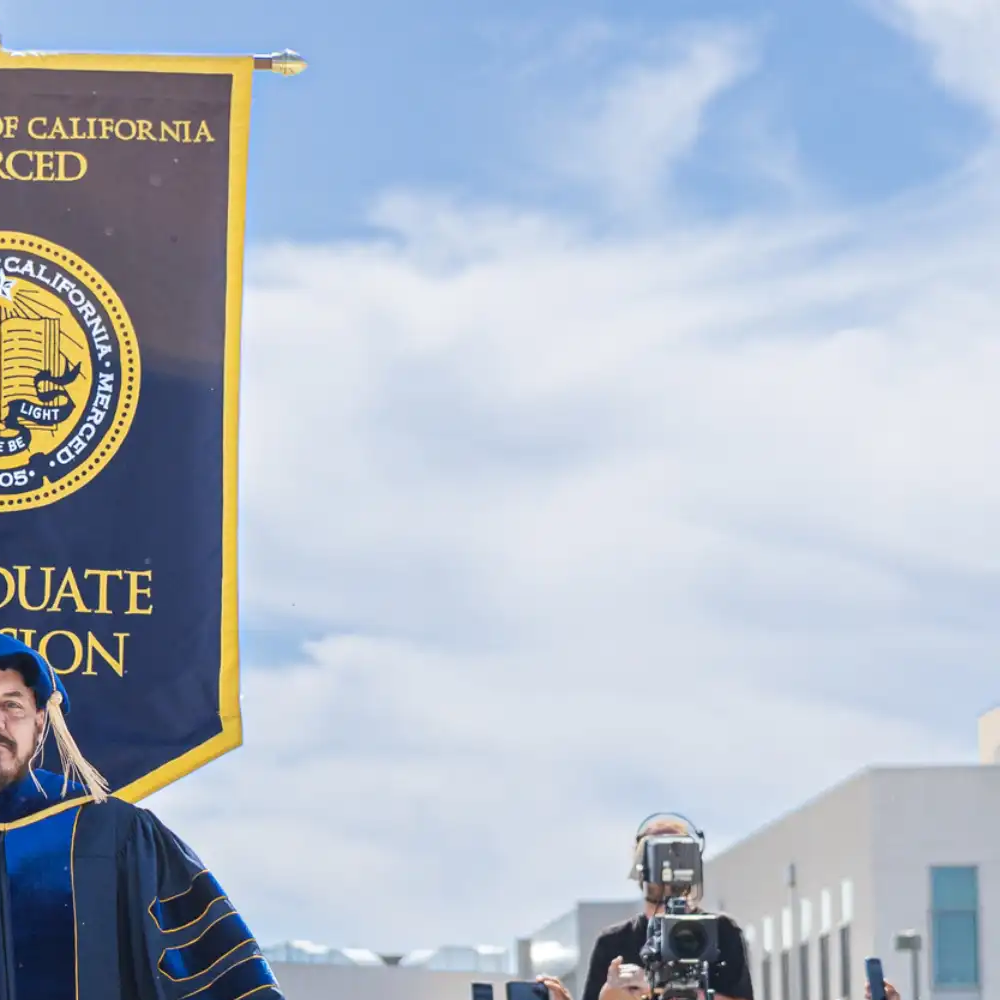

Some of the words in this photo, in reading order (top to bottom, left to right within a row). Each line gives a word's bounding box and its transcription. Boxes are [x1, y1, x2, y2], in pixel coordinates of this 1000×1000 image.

[27, 116, 215, 143] CALIFORNIA
[3, 255, 113, 361] CALIFORNIA
[7, 435, 26, 452] BE
[19, 402, 60, 421] LIGHT
[56, 372, 115, 465] MERCED
